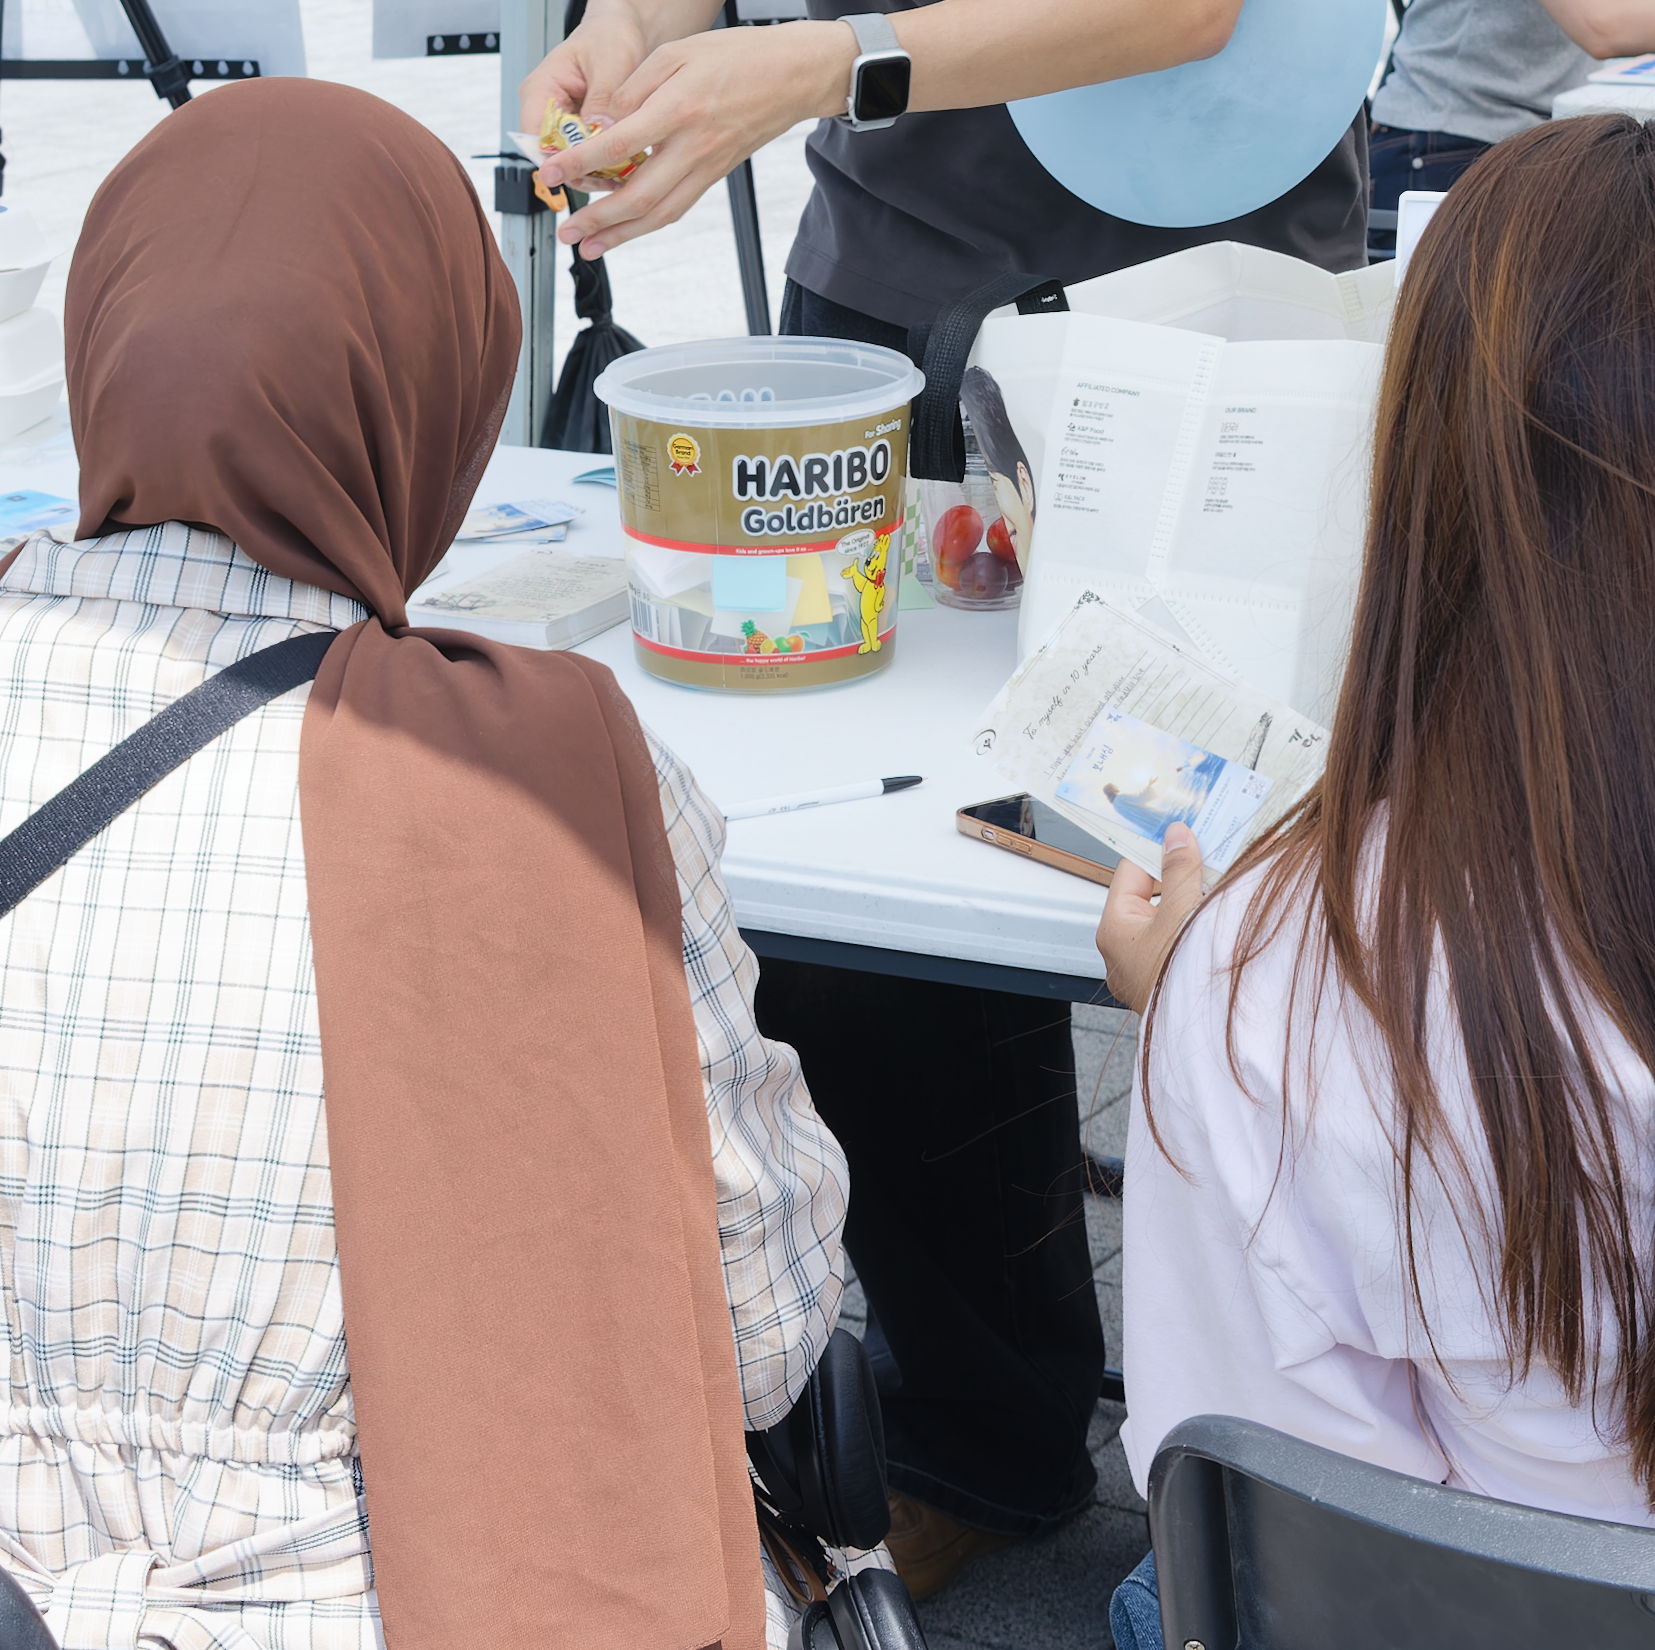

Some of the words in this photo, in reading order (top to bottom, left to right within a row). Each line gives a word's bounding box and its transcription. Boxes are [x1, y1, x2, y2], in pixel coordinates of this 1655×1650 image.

[1077, 382, 1111, 393] AFFILIATED
[1110, 386, 1141, 398] COMPANY
[864, 429, 876, 440] For
[876, 418, 902, 438] Sharing
[735, 440, 889, 500] HARIBO
[742, 495, 885, 535] Goldbären
[840, 540, 851, 548] The
[851, 533, 870, 545] Original
[844, 546, 858, 554] since
[754, 657, 769, 665] happy
[1023, 722, 1037, 740] To
[1038, 695, 1063, 726] myself
[1062, 685, 1071, 695] in
[1070, 669, 1080, 683] 10
[1082, 644, 1103, 676] years
